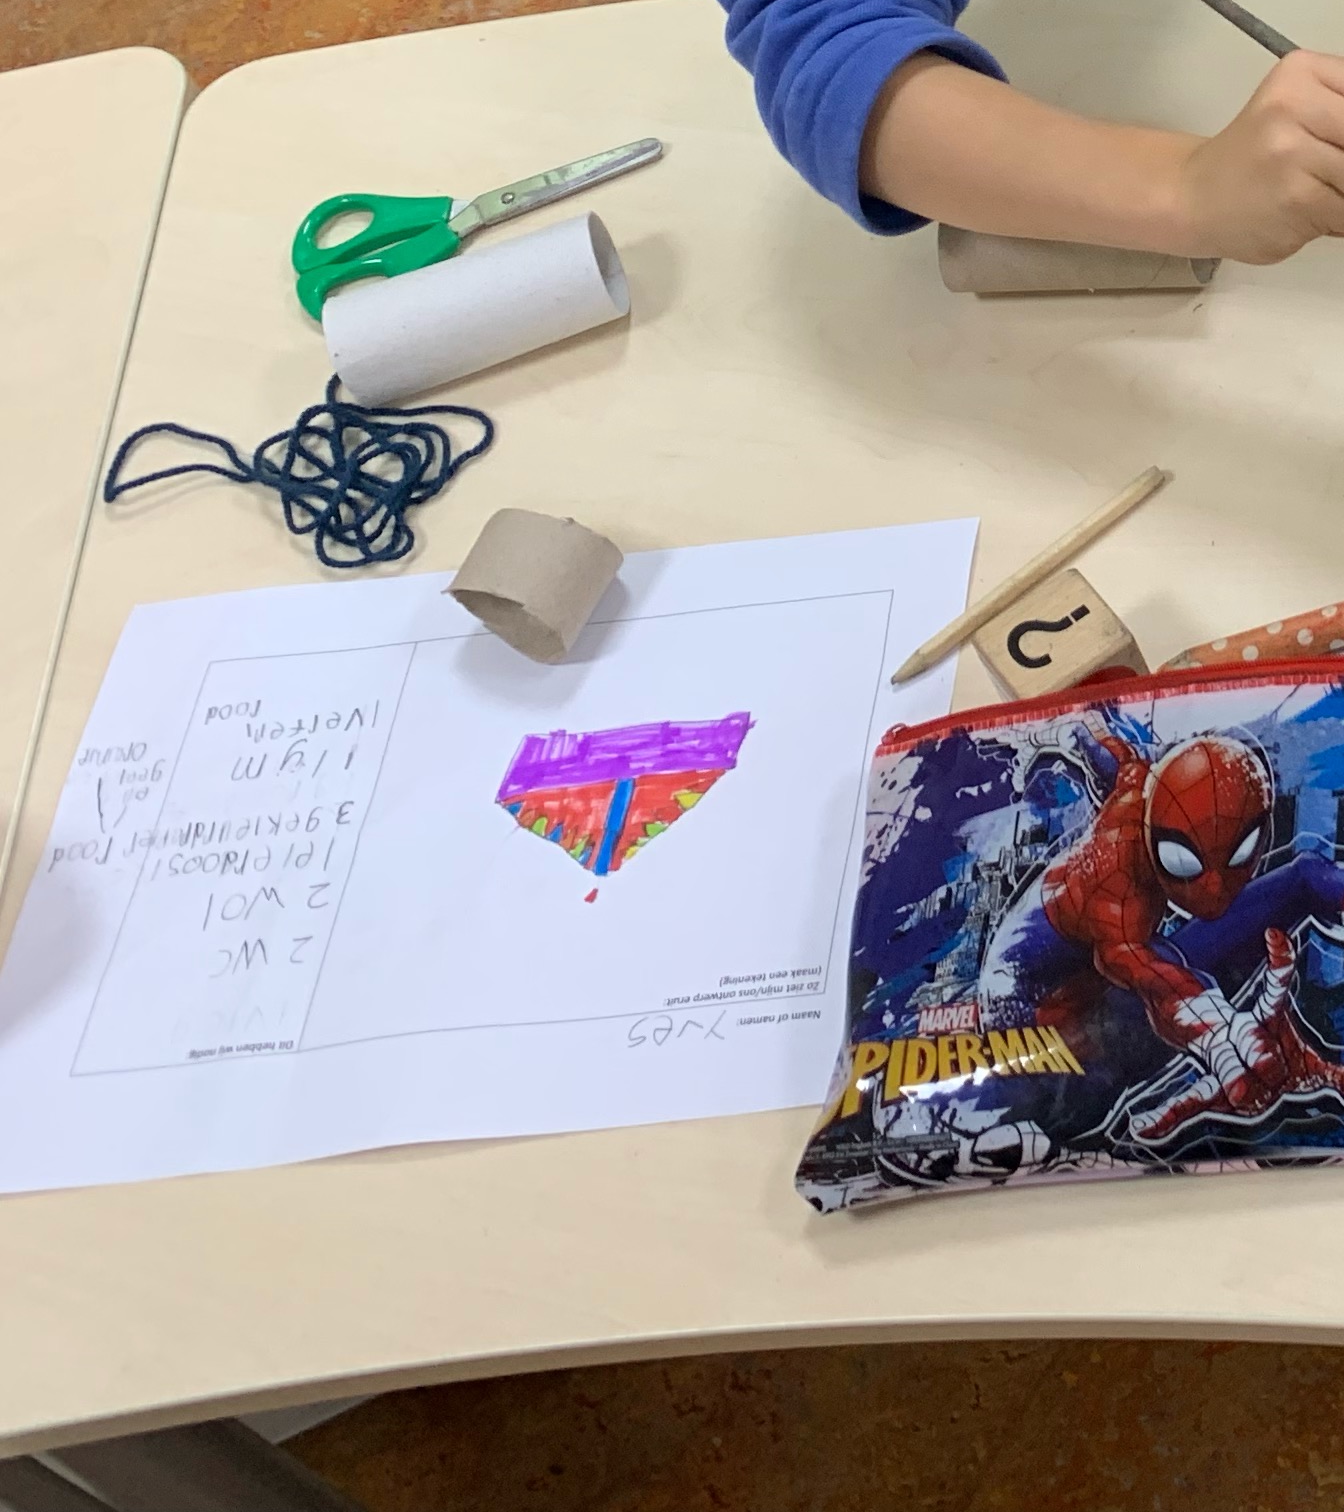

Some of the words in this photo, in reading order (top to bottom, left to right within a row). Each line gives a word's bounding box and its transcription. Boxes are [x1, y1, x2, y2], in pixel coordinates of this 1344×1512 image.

[204, 699, 262, 725] rood
[307, 883, 331, 909] 2
[289, 936, 314, 964] 2
[769, 971, 788, 980] een
[789, 965, 822, 979] (maak
[719, 972, 767, 988] tekening)
[807, 981, 820, 992] Zo
[738, 985, 785, 998] mijn/ons
[786, 983, 806, 993] ziet
[692, 989, 737, 1003] ontwerp
[737, 1015, 776, 1026] namen:
[777, 1013, 790, 1024] of
[791, 1010, 821, 1021] Naam
[918, 1002, 977, 1033] MARVEL
[236, 1041, 275, 1054] hebben
